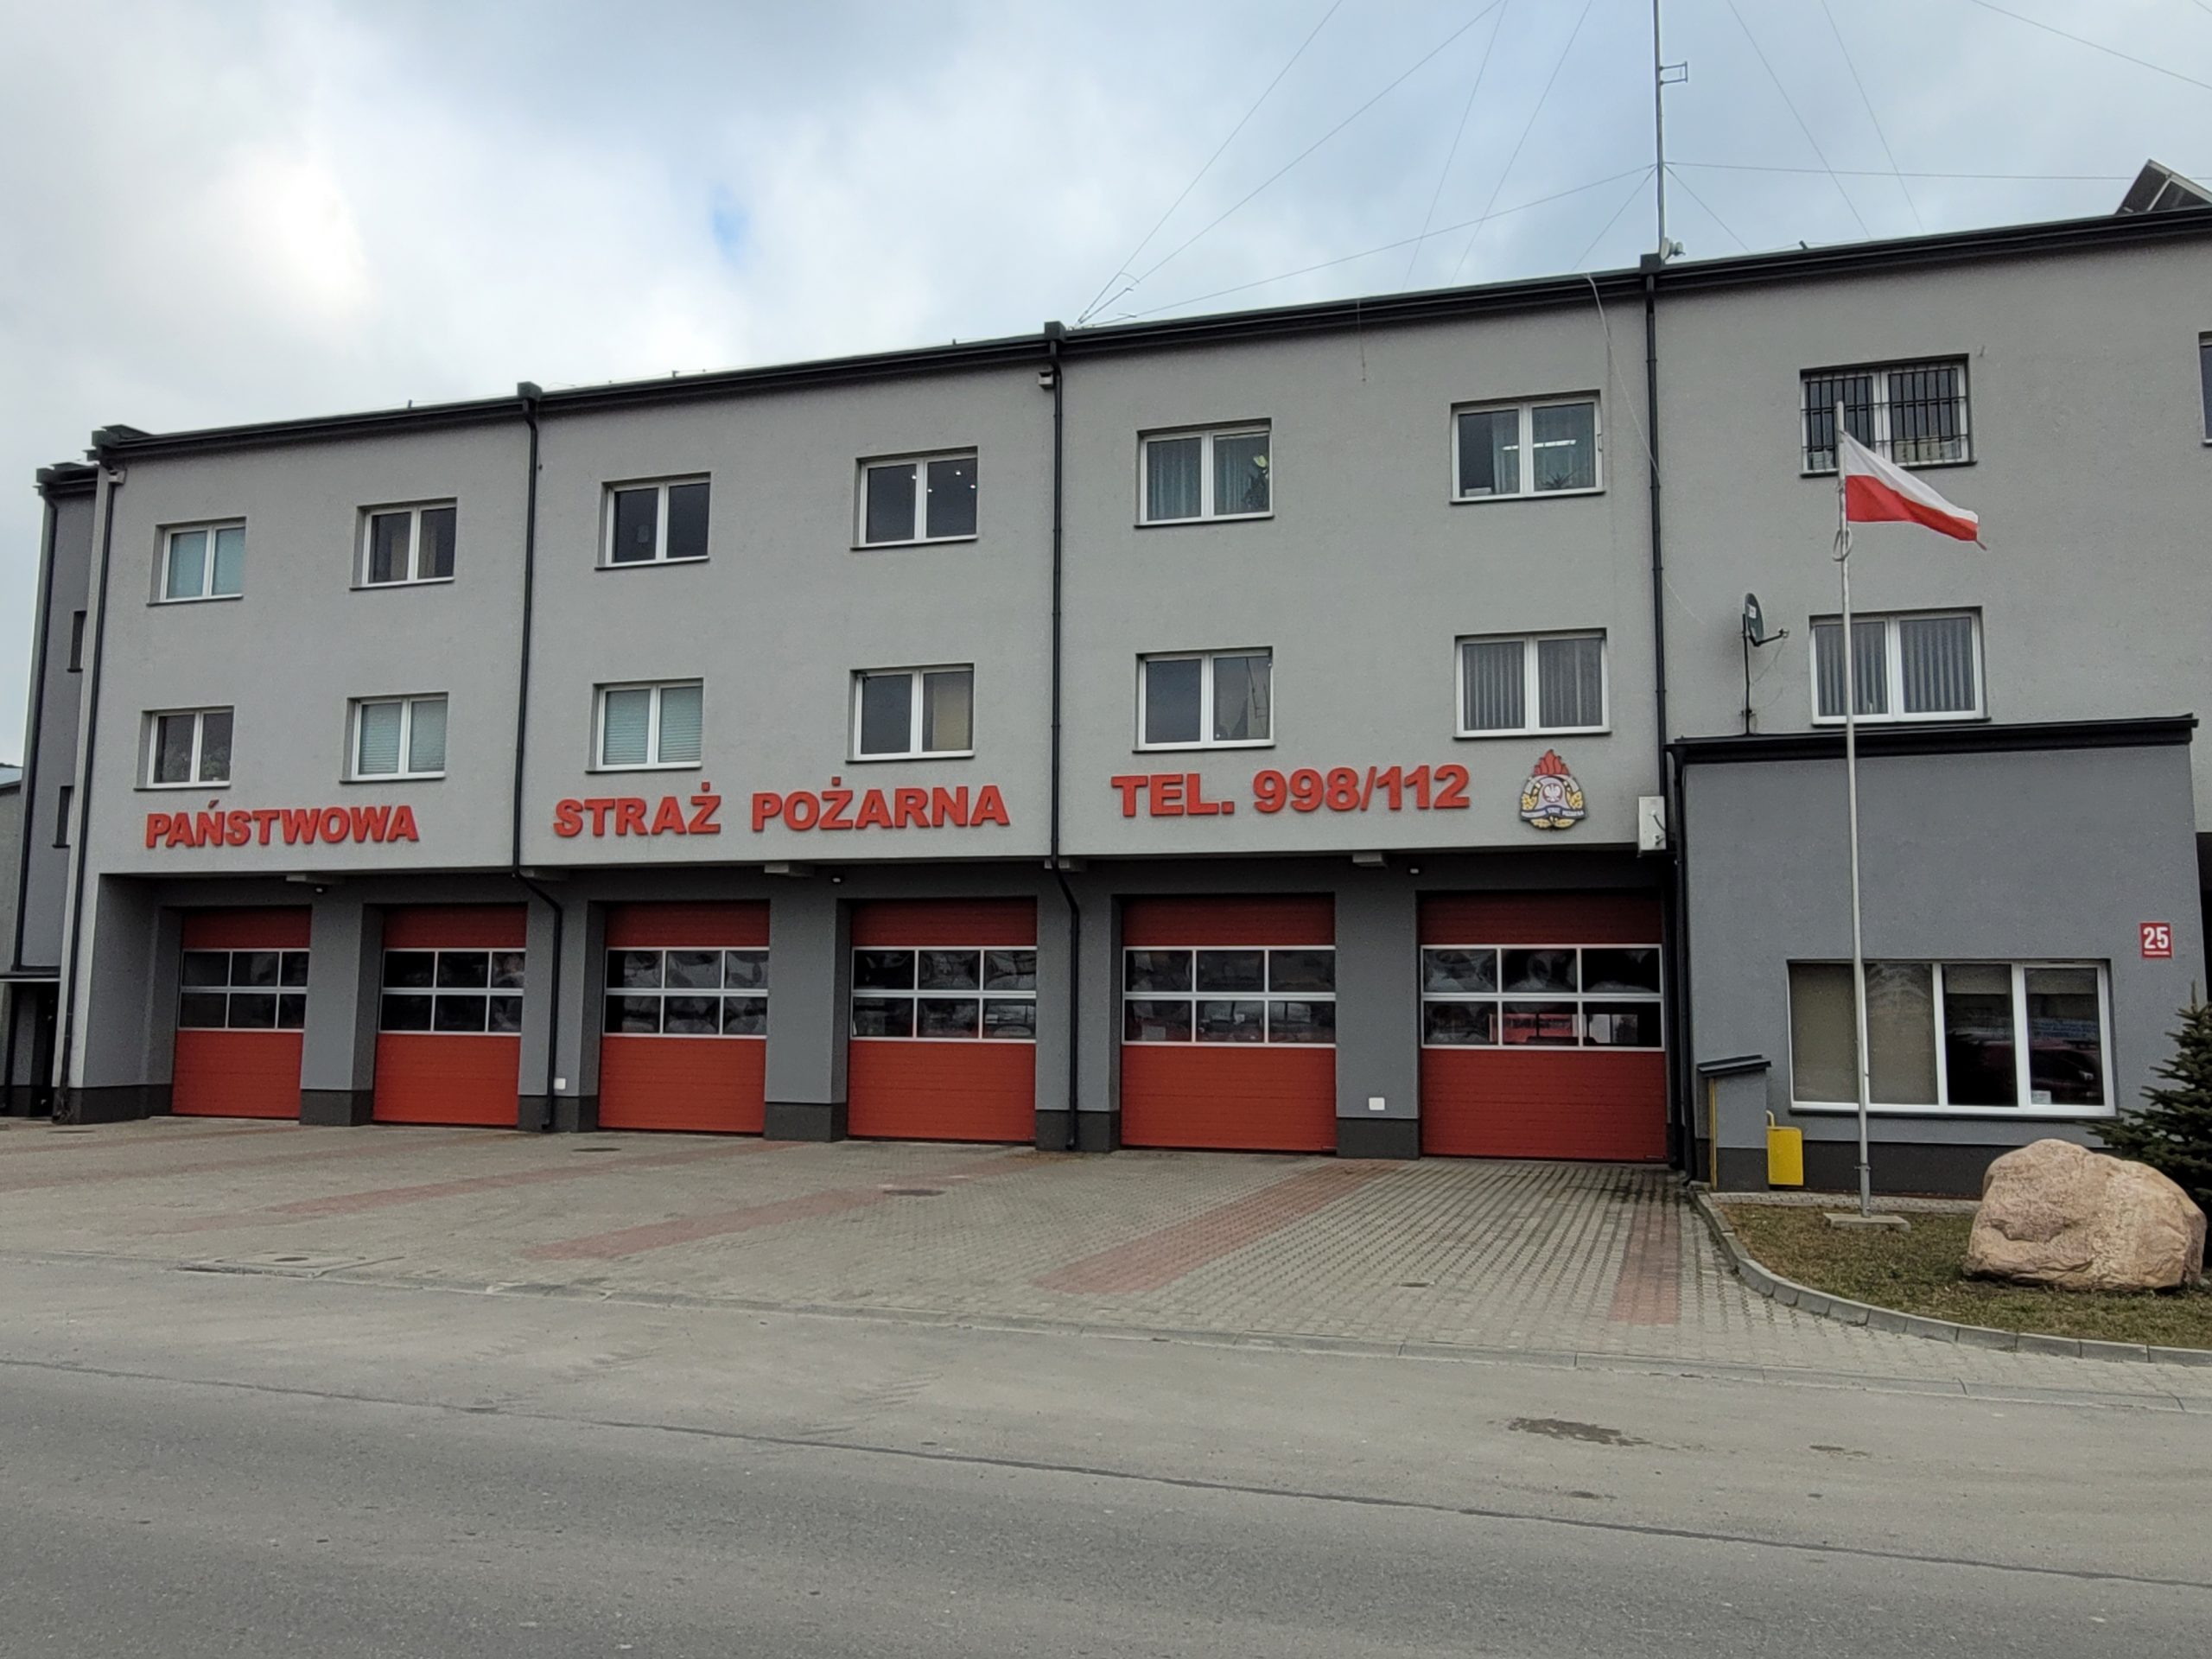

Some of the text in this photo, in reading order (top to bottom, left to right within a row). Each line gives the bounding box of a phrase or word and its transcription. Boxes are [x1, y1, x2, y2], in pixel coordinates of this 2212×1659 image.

[145, 776, 1010, 849] PAŃSTWOWA STRAŻ POŻARNA
[1111, 764, 1471, 817] TEL. 998/112
[2143, 926, 2169, 949] 25
